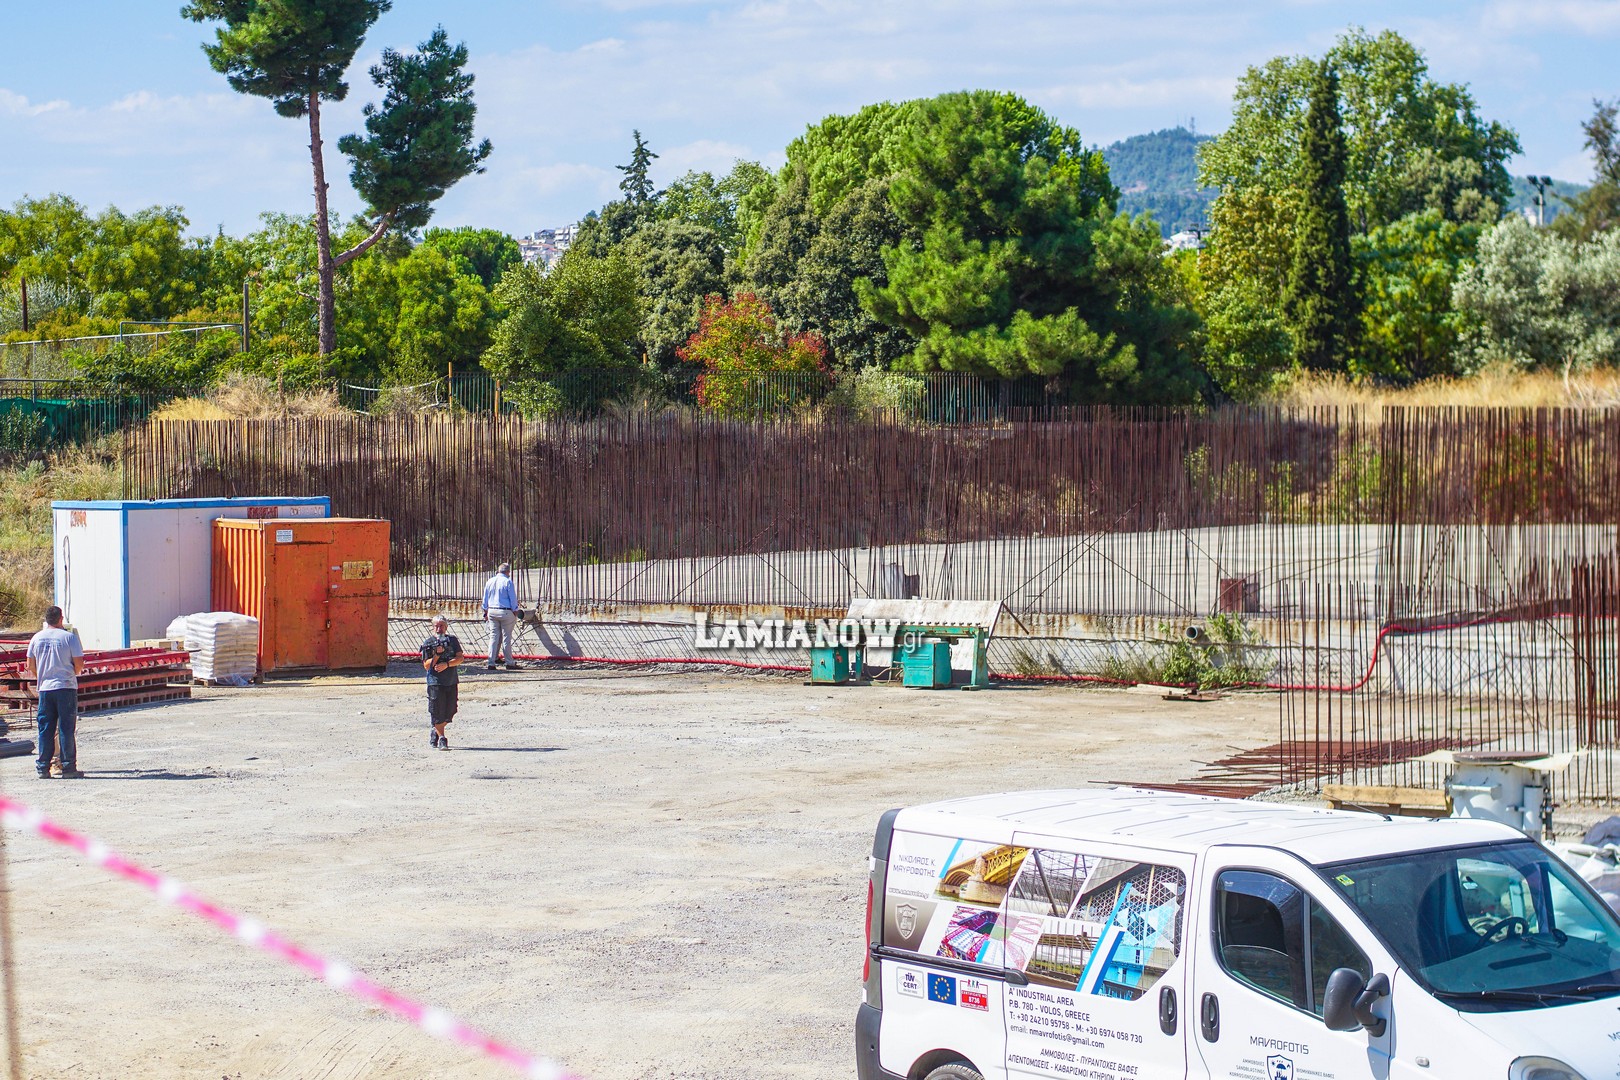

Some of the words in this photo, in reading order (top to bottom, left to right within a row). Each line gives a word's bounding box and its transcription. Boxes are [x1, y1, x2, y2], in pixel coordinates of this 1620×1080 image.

[903, 981, 918, 990] CERT
[905, 972, 915, 982] TÜV
[1016, 989, 1055, 1003] INDUSTRIAL
[1056, 996, 1075, 1007] AREA
[1008, 999, 1021, 1009] P.B.
[1022, 1001, 1034, 1011] 780
[1039, 1004, 1064, 1018] VOLOS,
[1064, 1009, 1090, 1022] GREECE
[1009, 1011, 1016, 1020] T:
[1017, 1013, 1028, 1022] +30
[1029, 1015, 1049, 1026] 24210
[1050, 1018, 1070, 1030] 95758
[1075, 1023, 1084, 1033] M:
[1085, 1026, 1098, 1035] +30
[1099, 1028, 1115, 1038] 6974
[1116, 1031, 1129, 1041] 058
[1130, 1033, 1143, 1044] 730
[1010, 1025, 1028, 1034] email:
[1029, 1028, 1105, 1049] nmavrofotis@gmail.com
[1249, 1035, 1309, 1055] MAVROFOTIS
[1054, 1063, 1088, 1078] ΚΑΘΑΡΙΣΜΟΙ
[1080, 1055, 1117, 1071] ΠΥΡΑΝΤΟΧΕΣ
[1117, 1063, 1138, 1075] ΒΑΦΕΣ
